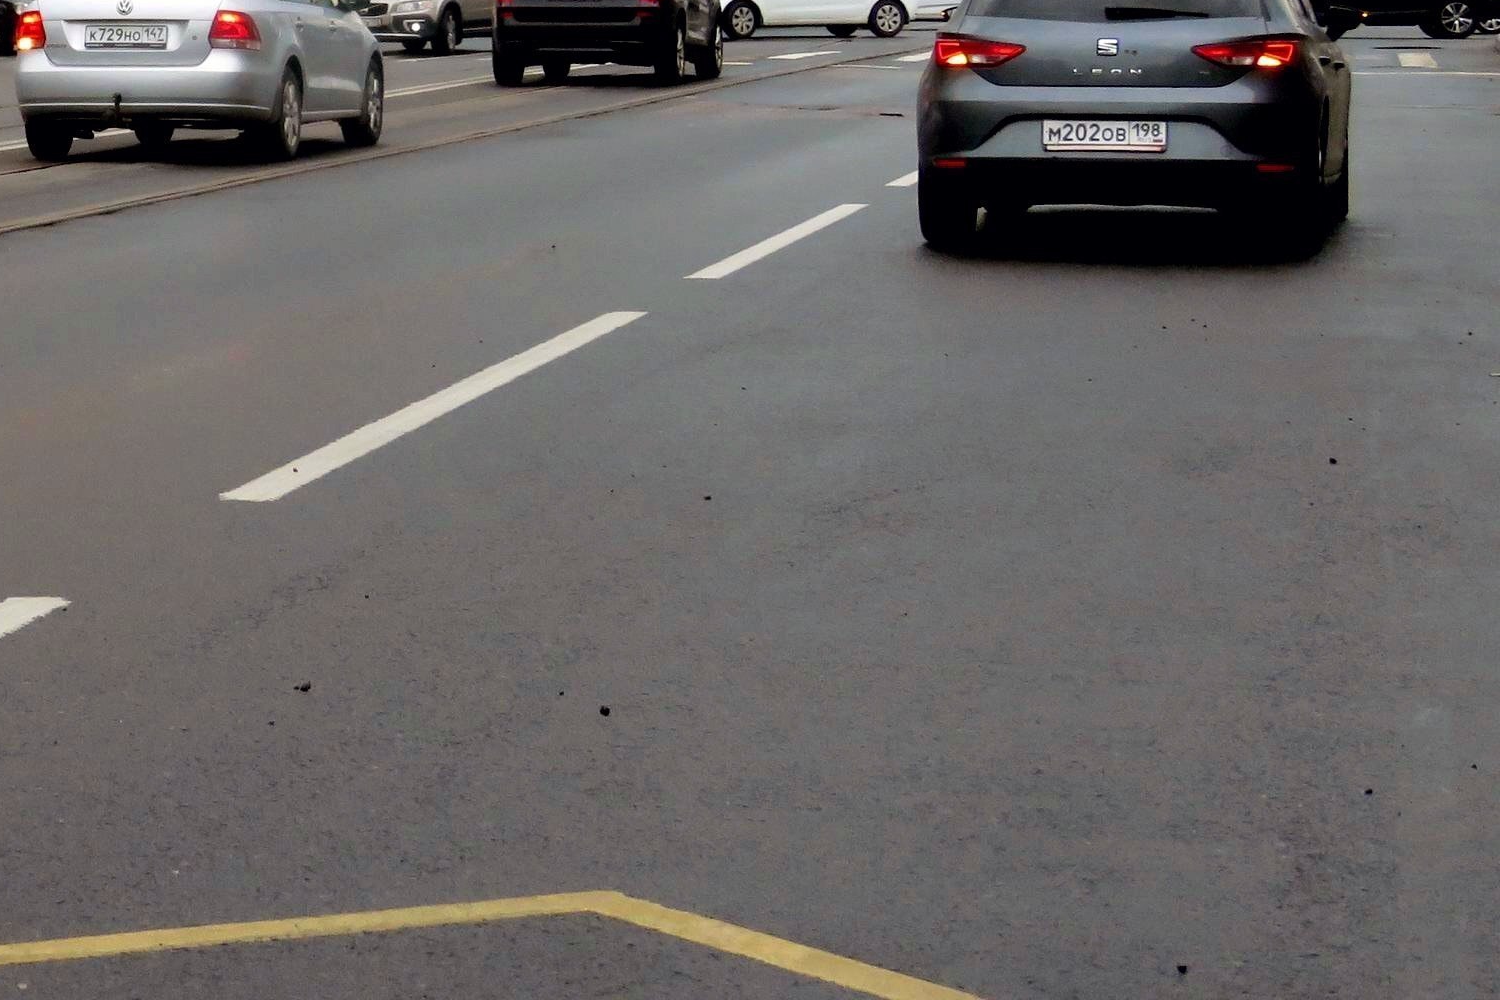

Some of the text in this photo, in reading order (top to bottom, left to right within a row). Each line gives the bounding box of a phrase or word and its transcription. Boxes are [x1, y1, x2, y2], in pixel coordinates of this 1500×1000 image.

[89, 27, 163, 41] К729НО 147
[1048, 123, 1161, 142] М202ОВ 198
